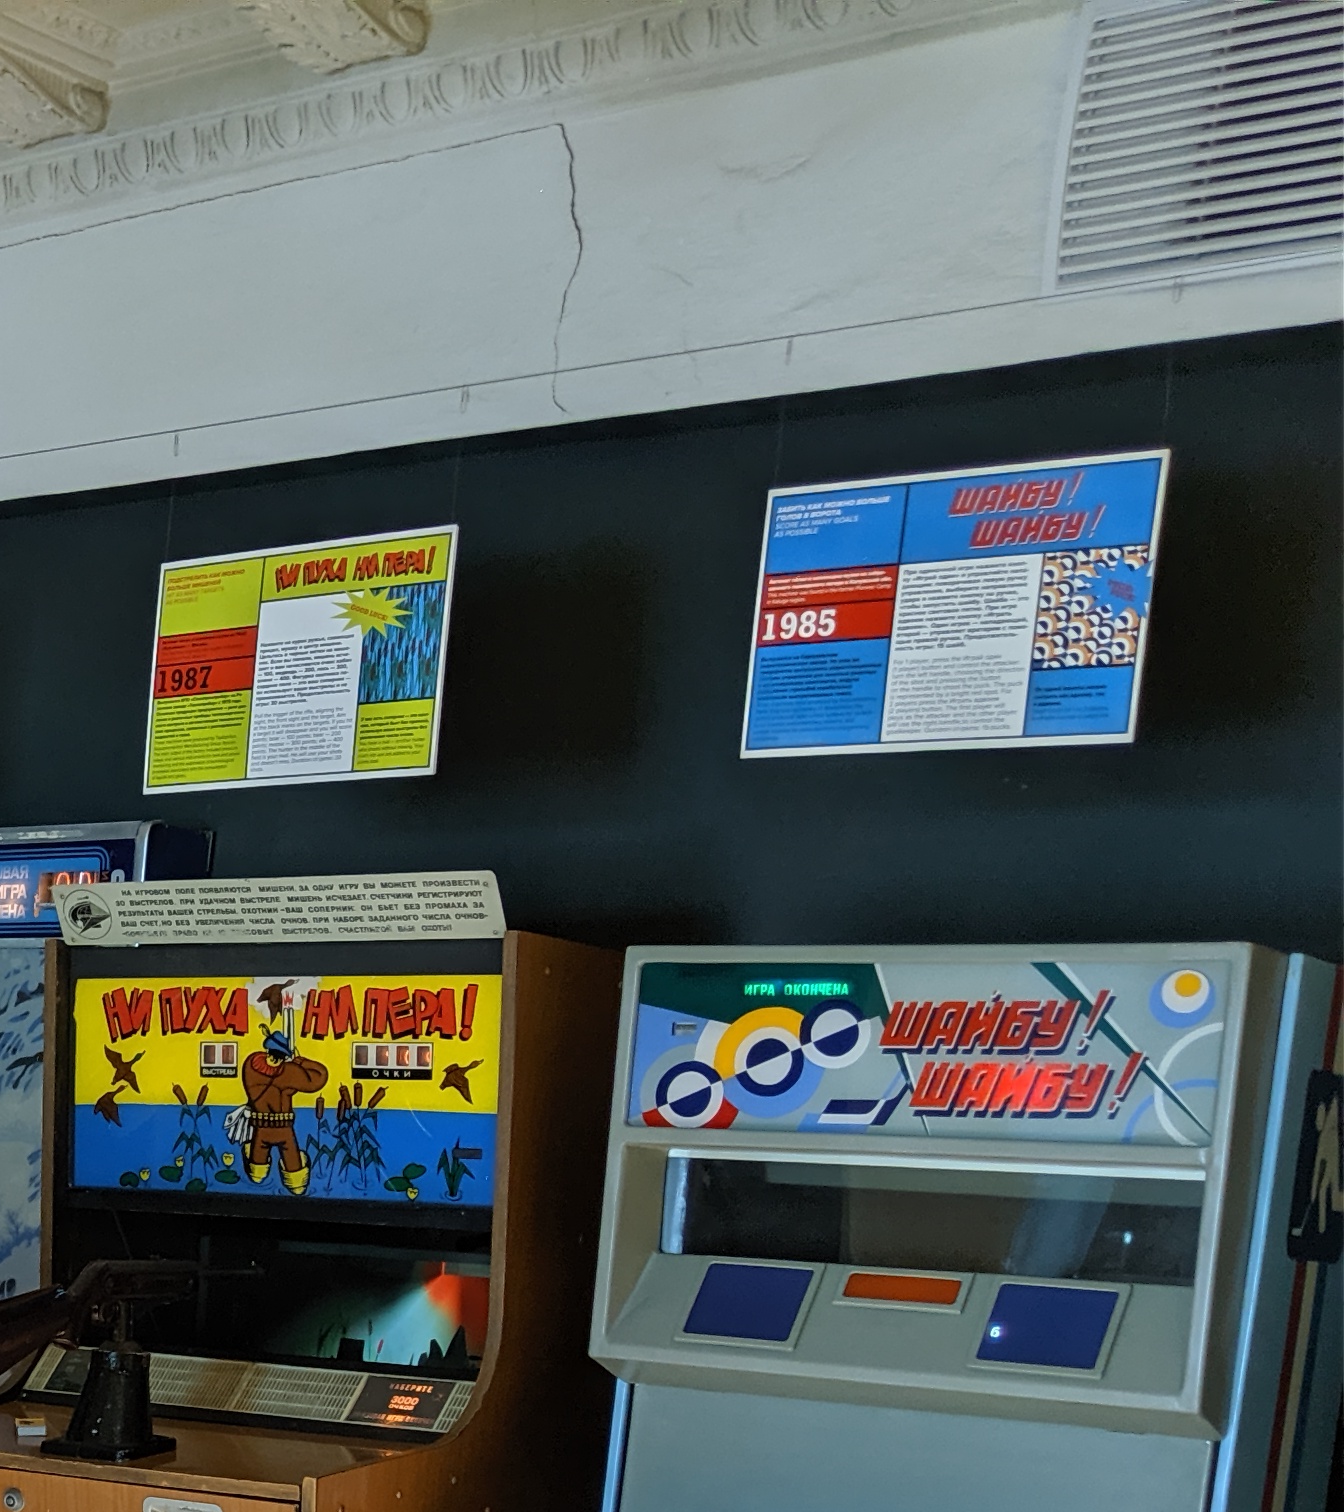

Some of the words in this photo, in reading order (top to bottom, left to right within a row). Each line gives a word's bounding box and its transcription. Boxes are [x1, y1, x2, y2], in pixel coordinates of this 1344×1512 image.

[273, 561, 301, 593] НИ
[301, 556, 348, 586] ПУХА
[352, 552, 381, 581] НИ
[380, 545, 436, 580] ПЕРА!
[761, 608, 837, 640] 1985
[157, 665, 212, 692] 1987
[135, 888, 170, 896] ИГРОВОМ
[174, 887, 195, 895] ПОЛЕ
[198, 885, 251, 894] ПОЯВЛЯЮТСЯ
[298, 883, 310, 891] ЗА
[379, 880, 417, 888] МОЖЕТЕ
[422, 878, 480, 887] ПРОИЗВЕСТИ
[286, 894, 322, 902] МИШЕНЬ
[416, 889, 482, 898] РЕГИСТРИРУЮТ
[117, 909, 164, 917] РЕЗУЛЬТАТЫ
[360, 903, 372, 911] ОН
[403, 902, 420, 910] БЕЗ
[425, 901, 468, 909] ПРОМАХА
[472, 900, 484, 908] ЗА
[312, 915, 329, 923] ПРИ
[421, 912, 451, 920] ЧИСЛА
[744, 983, 775, 997] ИГРА
[784, 981, 849, 997] ОКОНЧЕНА
[102, 989, 154, 1043] НИ
[160, 986, 249, 1036] ПУХА
[302, 984, 359, 1040] НИ
[360, 984, 479, 1041] ПЕРА!
[201, 1068, 236, 1077] ВЫСТРЕЛЫ
[371, 1069, 412, 1079] ОЧКИ
[391, 1396, 419, 1405] 3000
